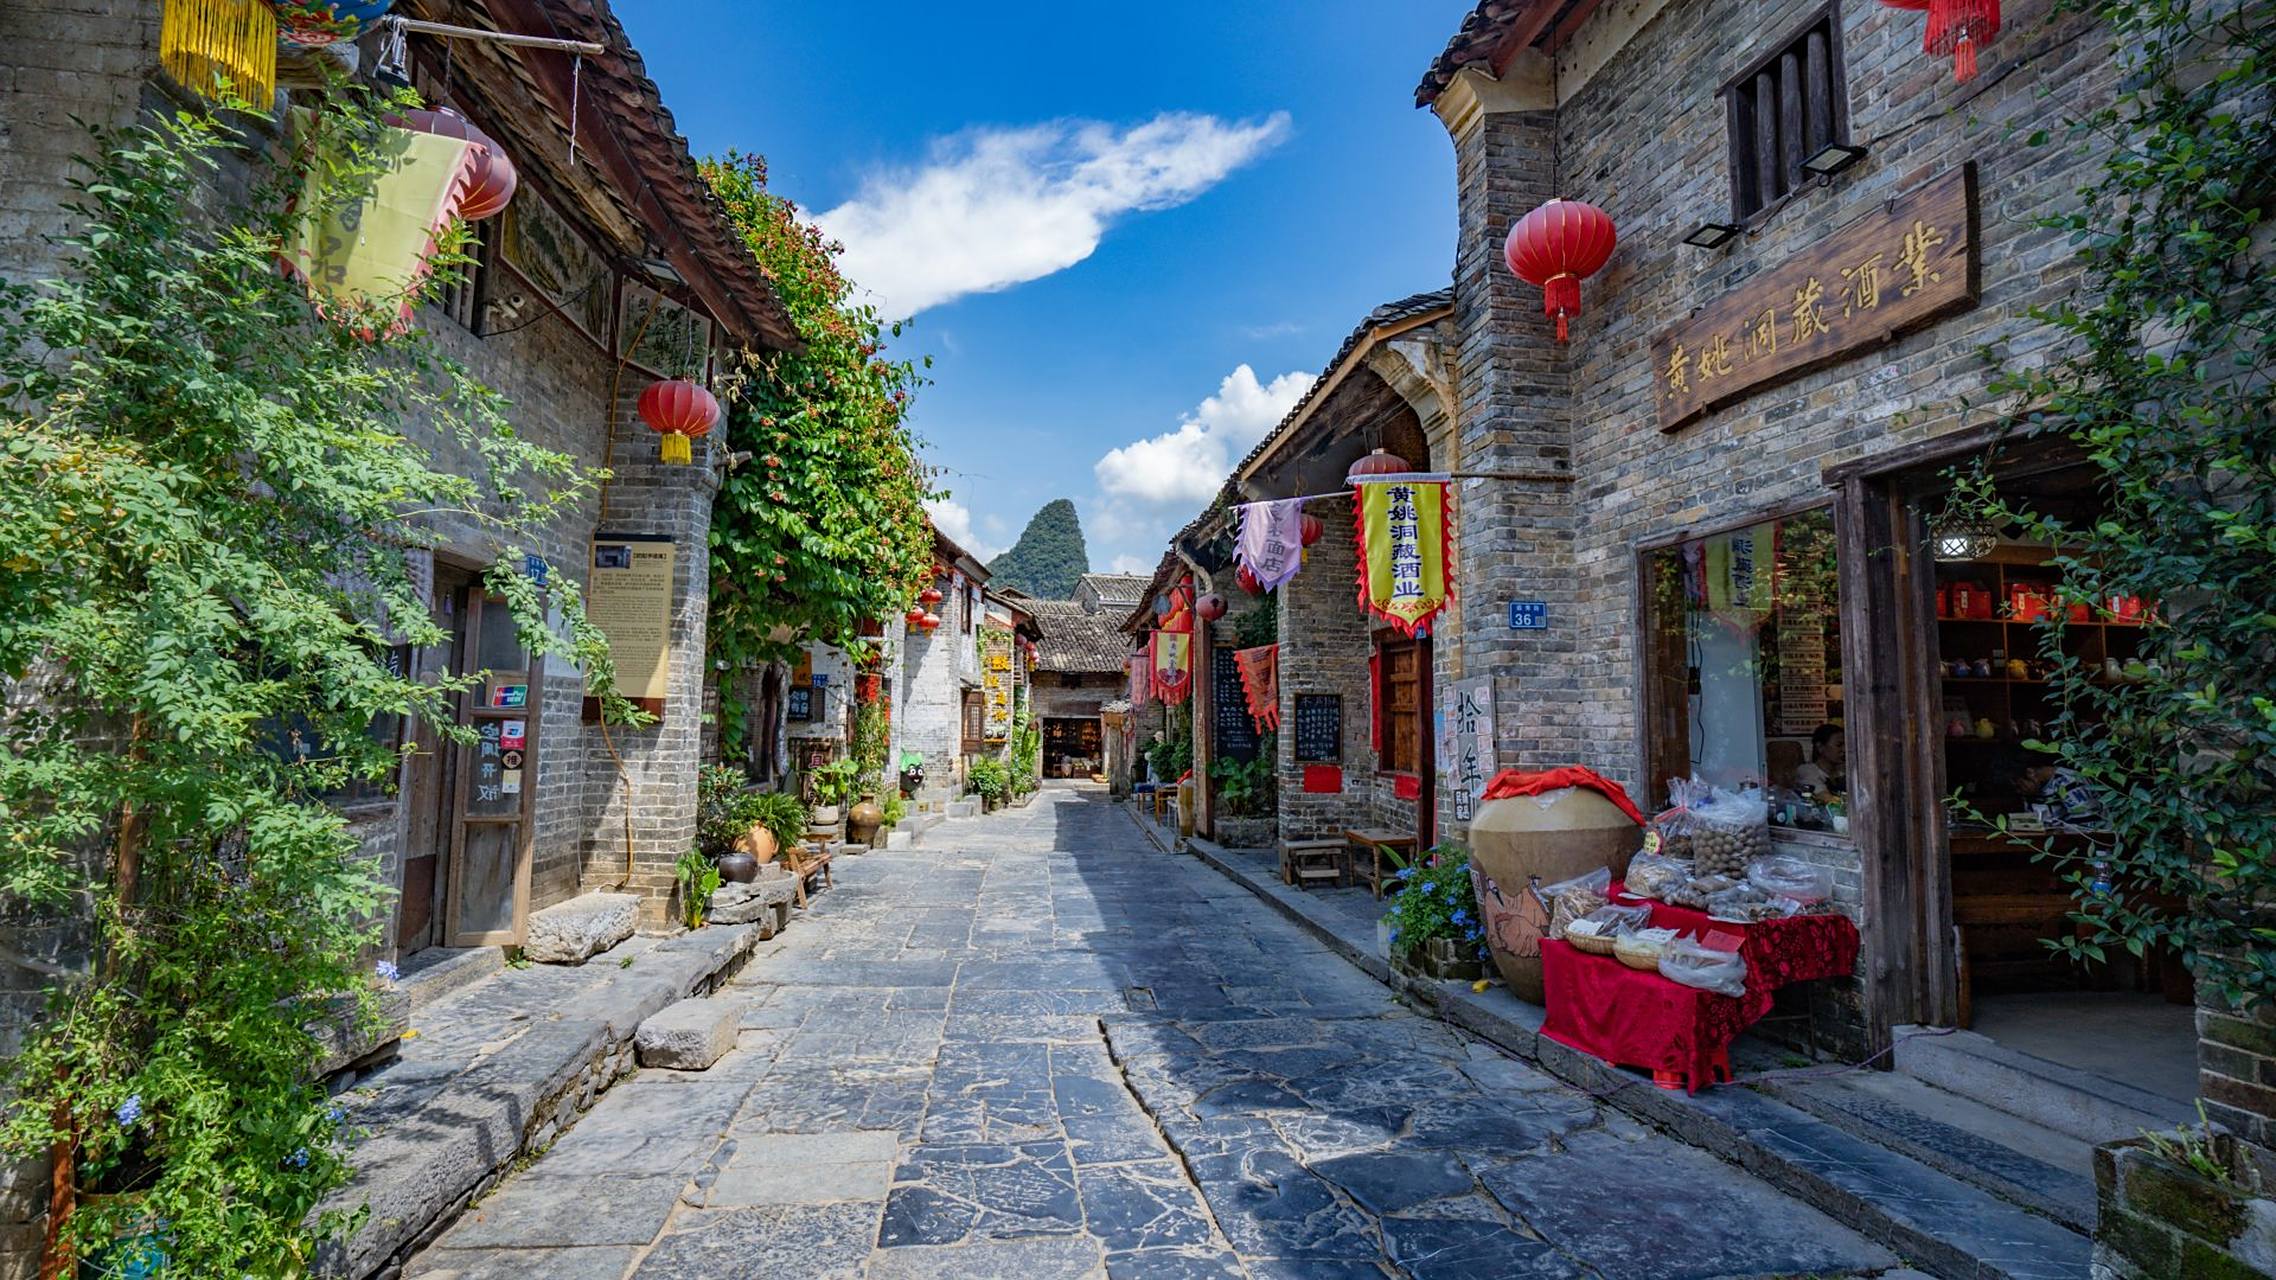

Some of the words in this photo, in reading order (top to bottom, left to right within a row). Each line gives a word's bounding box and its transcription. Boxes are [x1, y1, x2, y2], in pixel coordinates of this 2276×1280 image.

[1386, 486, 1425, 598] 黄姚洞藏酒业
[1515, 613, 1532, 626] 36
[1457, 691, 1483, 794] 拾年
